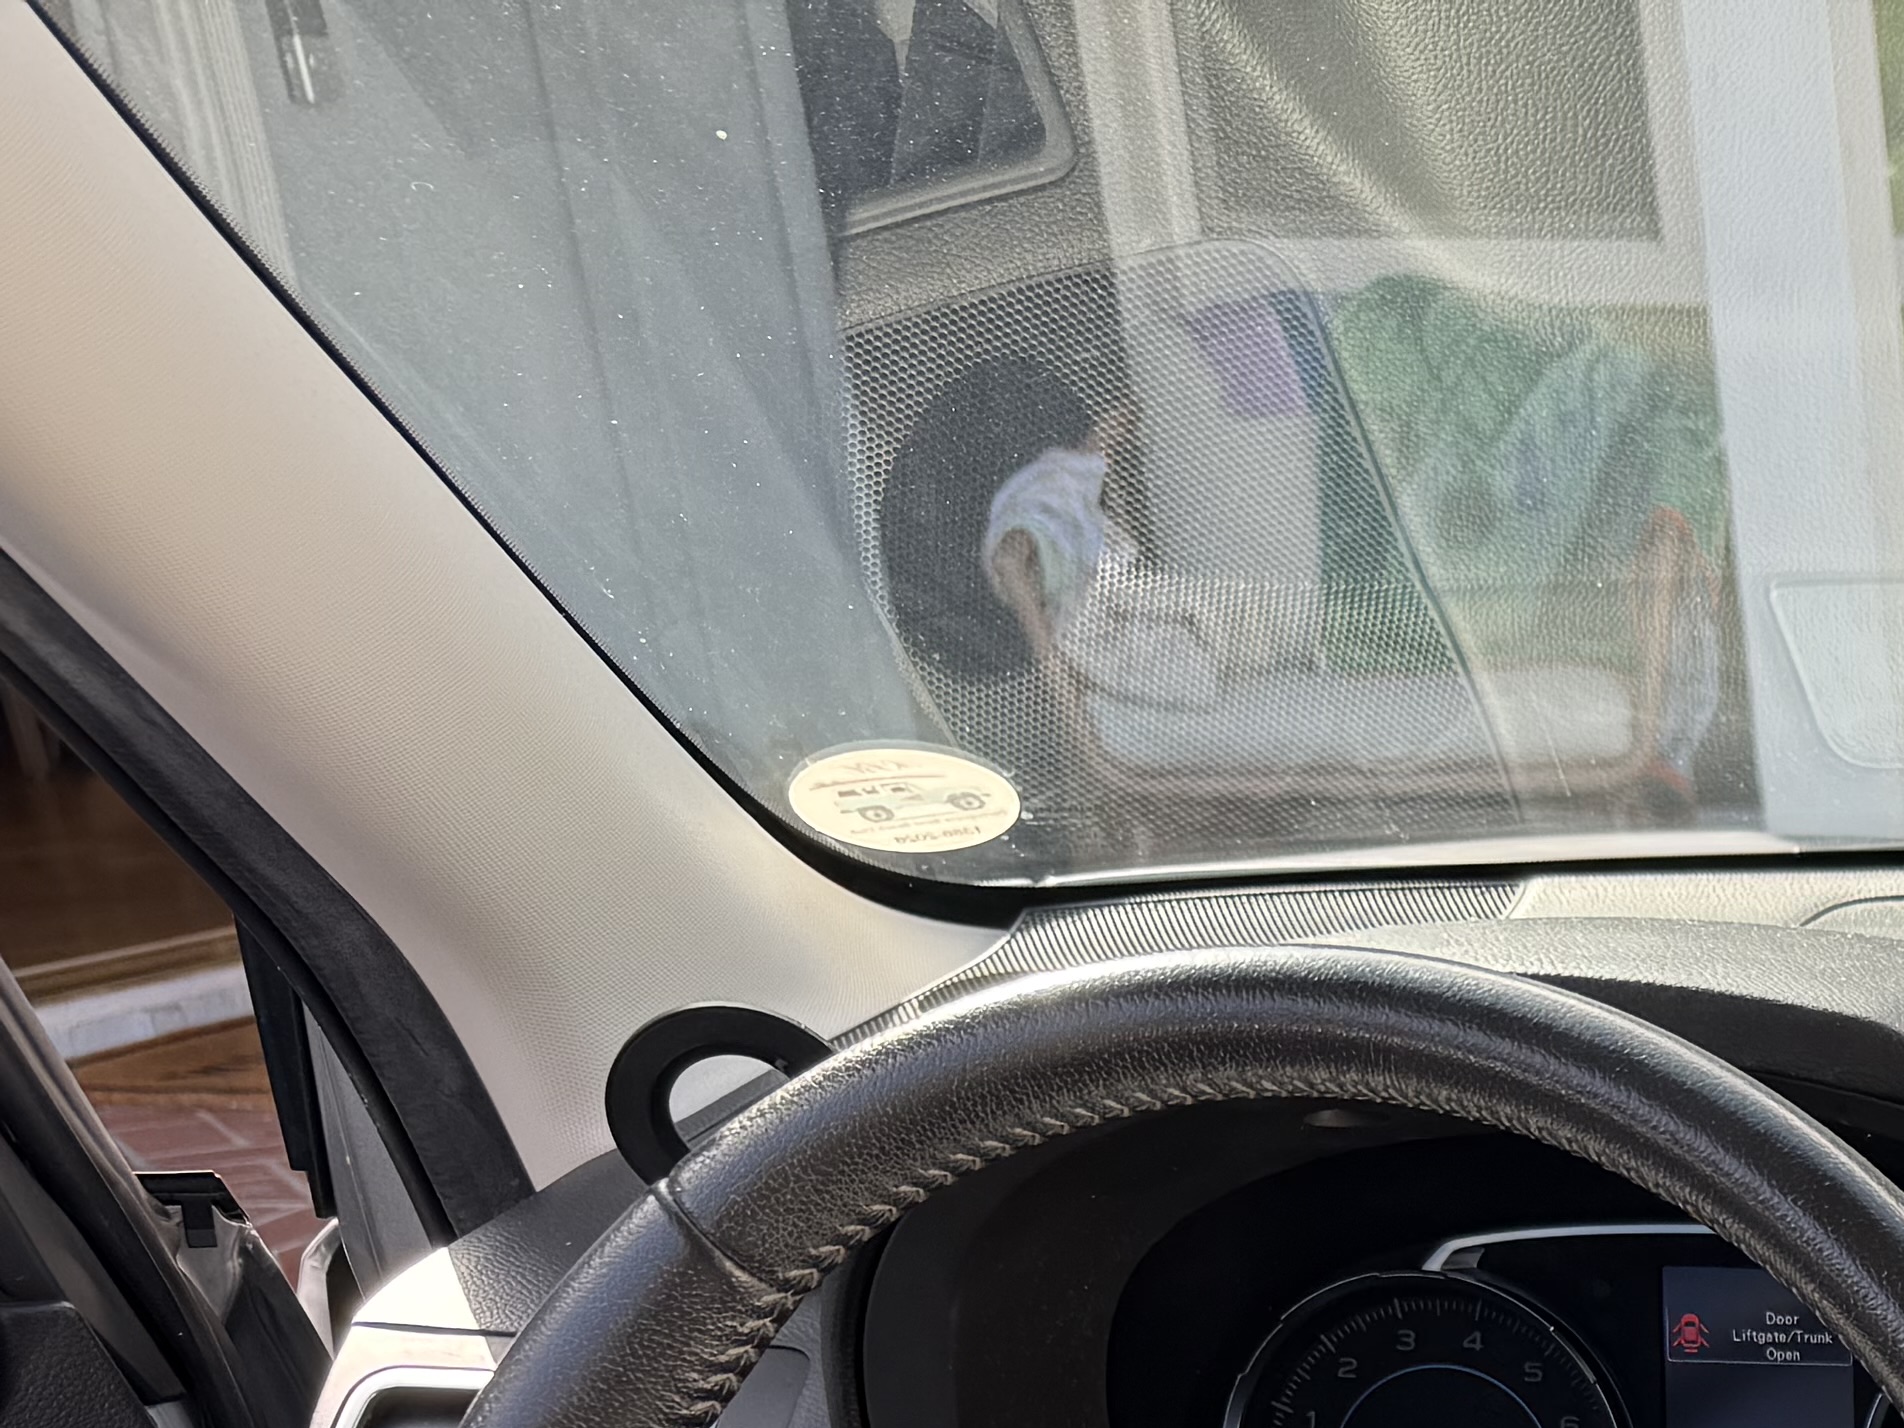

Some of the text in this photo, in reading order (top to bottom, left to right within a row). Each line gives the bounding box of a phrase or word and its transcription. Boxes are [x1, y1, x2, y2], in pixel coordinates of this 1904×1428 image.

[1765, 1311, 1800, 1326] Door
[1395, 1330, 1416, 1351] 3
[1462, 1331, 1485, 1351] 4
[1732, 1328, 1833, 1347] Liftgate/Trunk
[1765, 1349, 1801, 1363] Open
[1337, 1357, 1358, 1378] 2
[1523, 1362, 1544, 1383] 5
